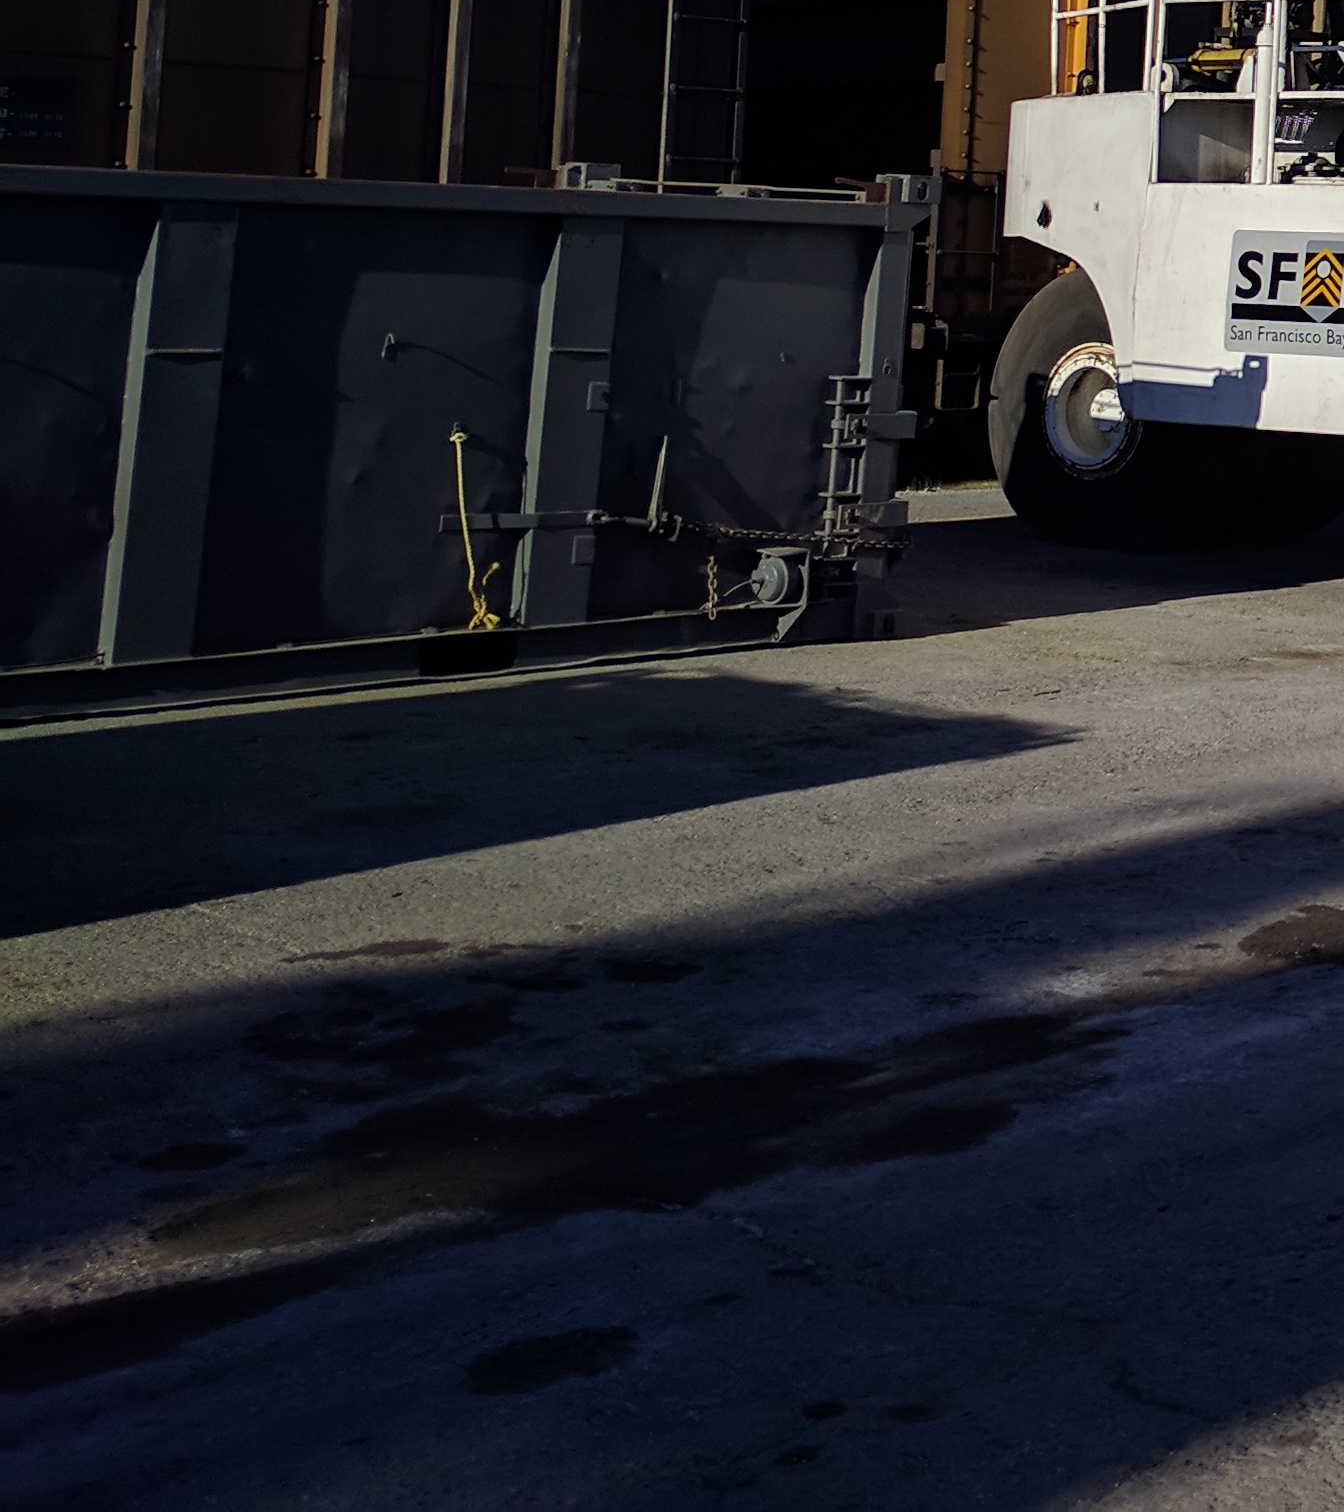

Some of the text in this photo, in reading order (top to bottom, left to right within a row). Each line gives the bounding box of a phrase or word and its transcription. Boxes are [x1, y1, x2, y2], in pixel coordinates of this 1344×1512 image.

[1235, 250, 1299, 300] SF
[1230, 325, 1252, 341] San
[1257, 326, 1322, 344] Francisco
